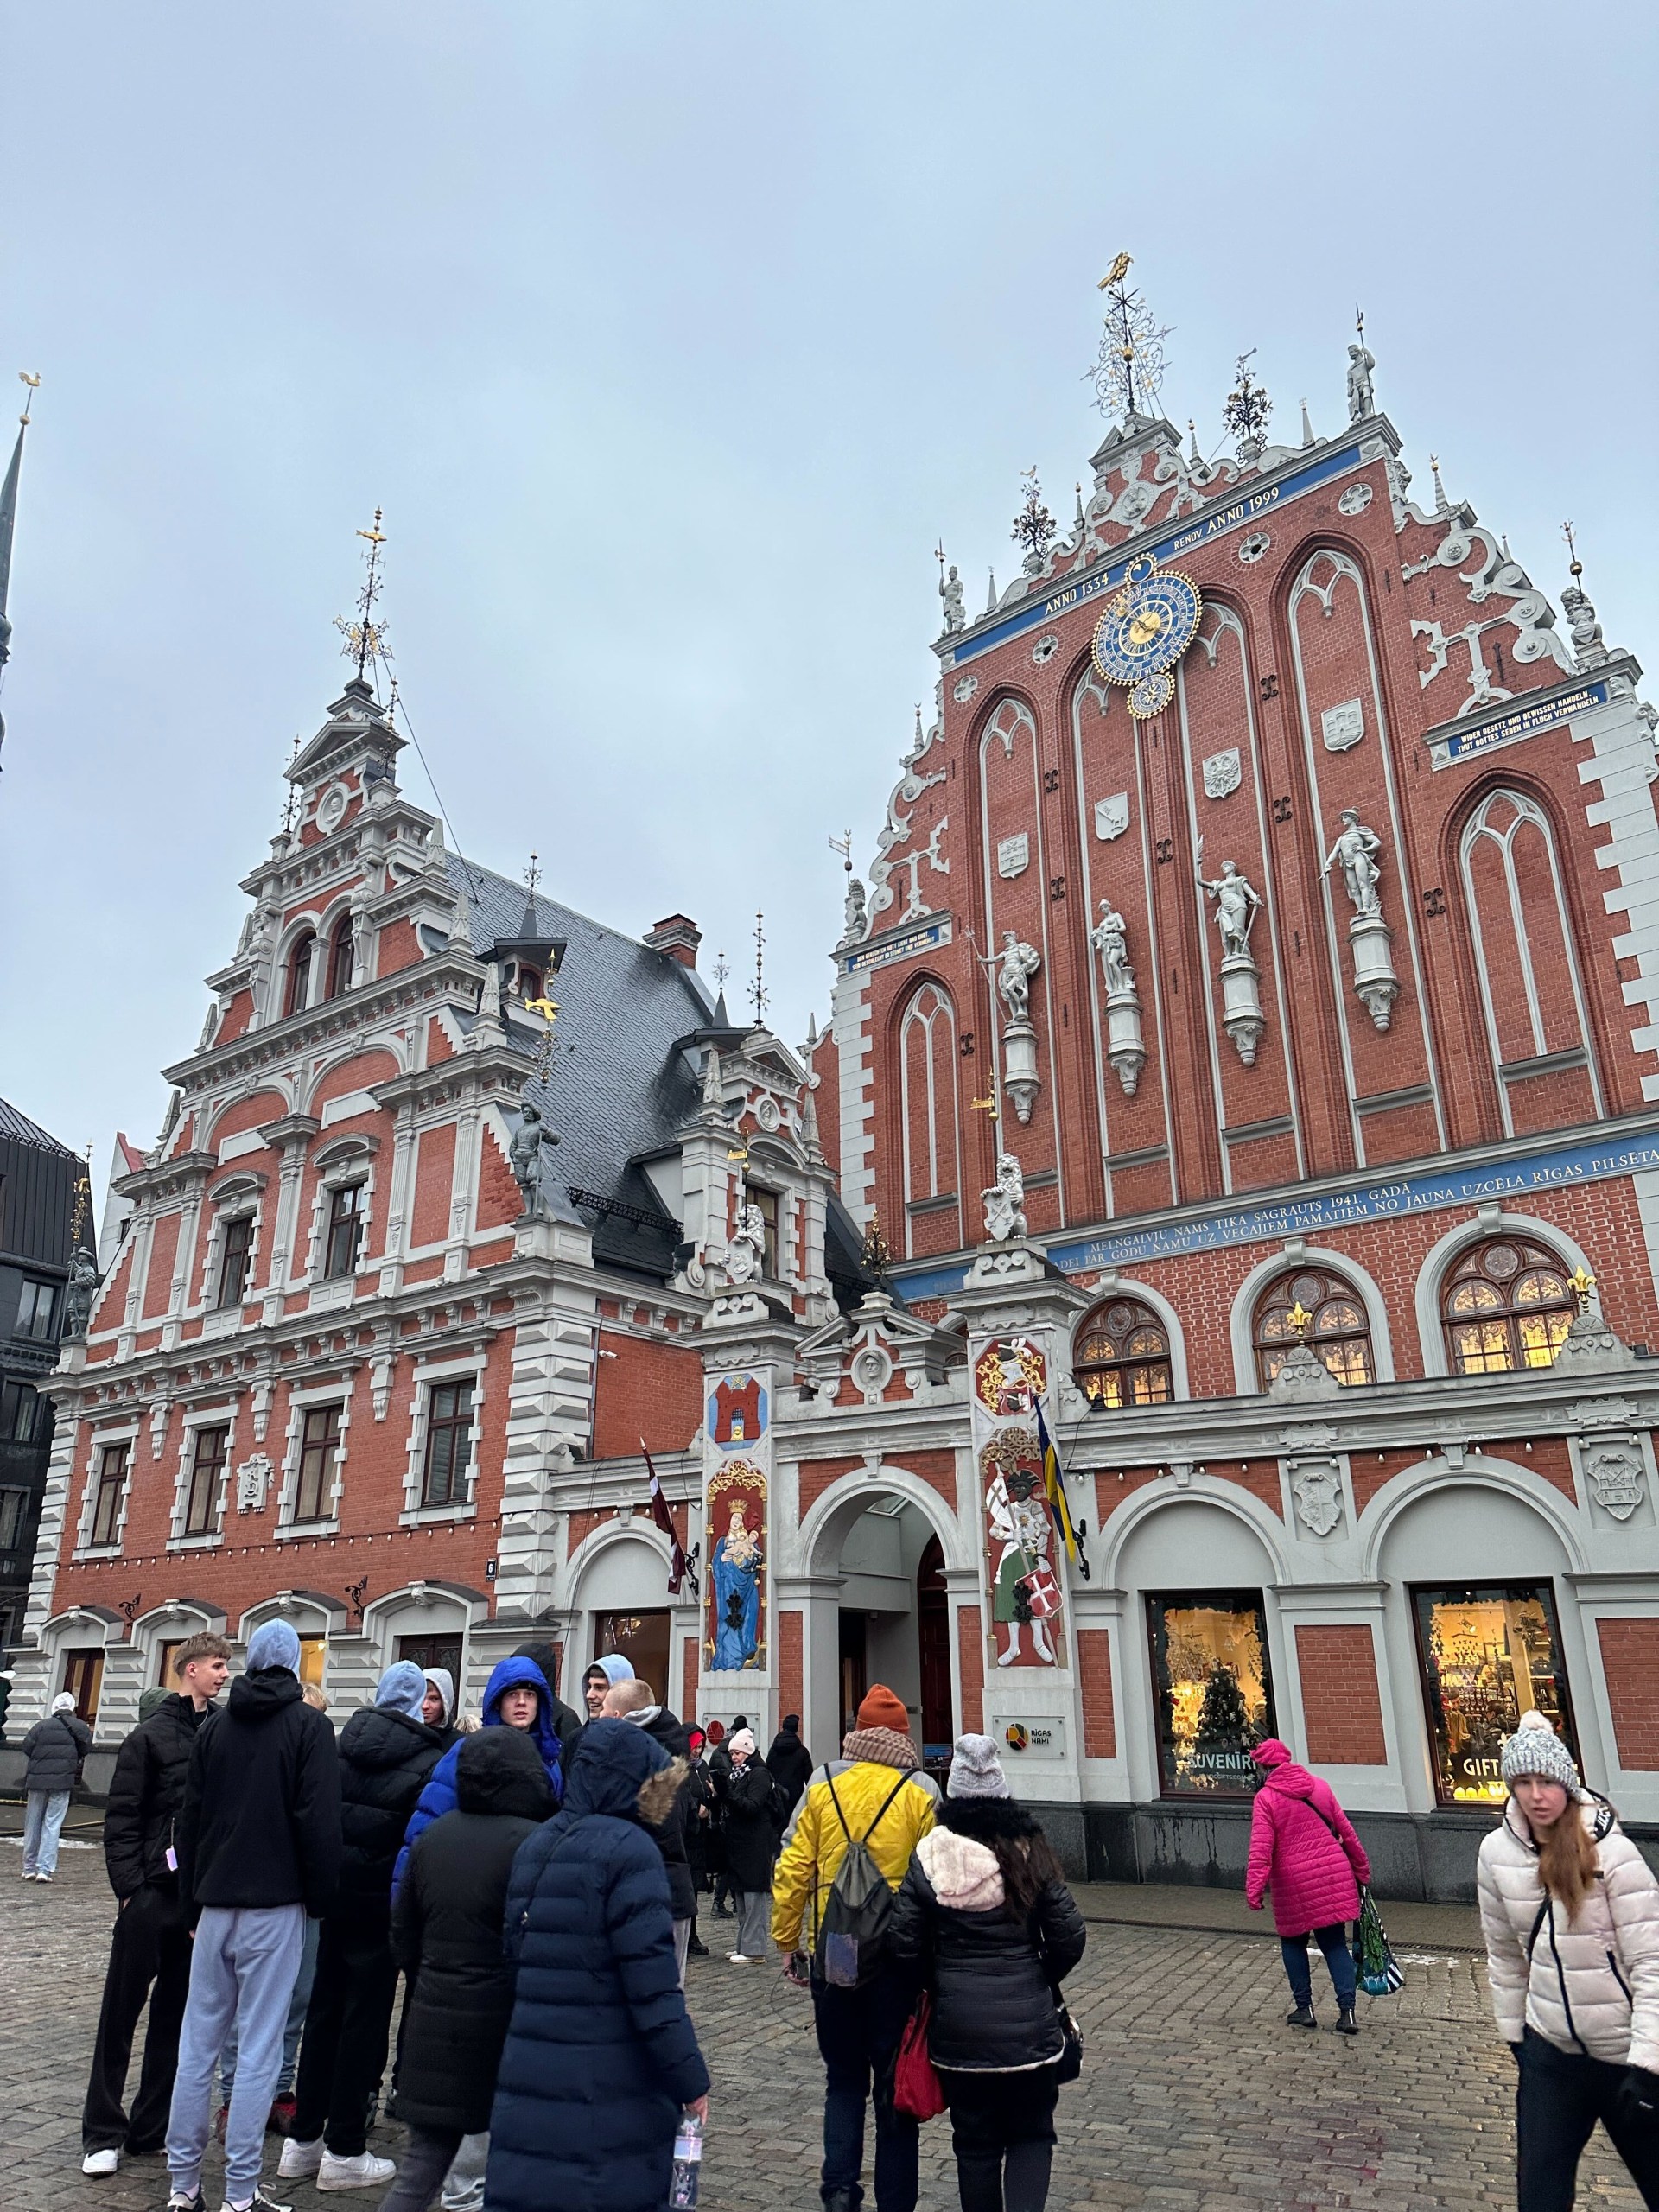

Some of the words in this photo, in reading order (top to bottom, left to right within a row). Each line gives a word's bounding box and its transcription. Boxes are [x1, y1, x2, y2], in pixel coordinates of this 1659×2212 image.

[1206, 505, 1244, 535] ANNO
[1249, 487, 1279, 512] 1999
[1045, 588, 1077, 615] ANNO
[1082, 572, 1109, 597] 1334
[1458, 741, 1473, 753] THUT
[1523, 721, 1530, 729] IN
[1532, 715, 1553, 727] FLUCH
[1554, 696, 1599, 718] VERWANDELN
[1461, 730, 1481, 742] WIDER
[1508, 715, 1522, 726] UND
[1522, 703, 1556, 721] GEWISSEN
[1084, 1255, 1105, 1266] PAR
[1111, 1245, 1147, 1260] GODU
[1153, 1237, 1191, 1252] NAMU
[1198, 1232, 1217, 1245] UZ
[1223, 1219, 1288, 1239] VECAJIEM
[1295, 1205, 1368, 1226] PAMATIEM
[1375, 1199, 1398, 1212] NO
[1407, 1188, 1455, 1209] JAUNA
[1461, 1175, 1524, 1196] UZCĒLA
[1532, 1164, 1583, 1183] RĪGAS
[1592, 1149, 1659, 1172] PILSĒTA
[1174, 1222, 1209, 1237] NAMS
[1215, 1215, 1247, 1229] TIKA
[1254, 1201, 1322, 1223] SAGRAUTS
[1330, 1194, 1362, 1208] 1941.
[1369, 1182, 1415, 1200] GADĀ.
[488, 1563, 493, 1573] 6
